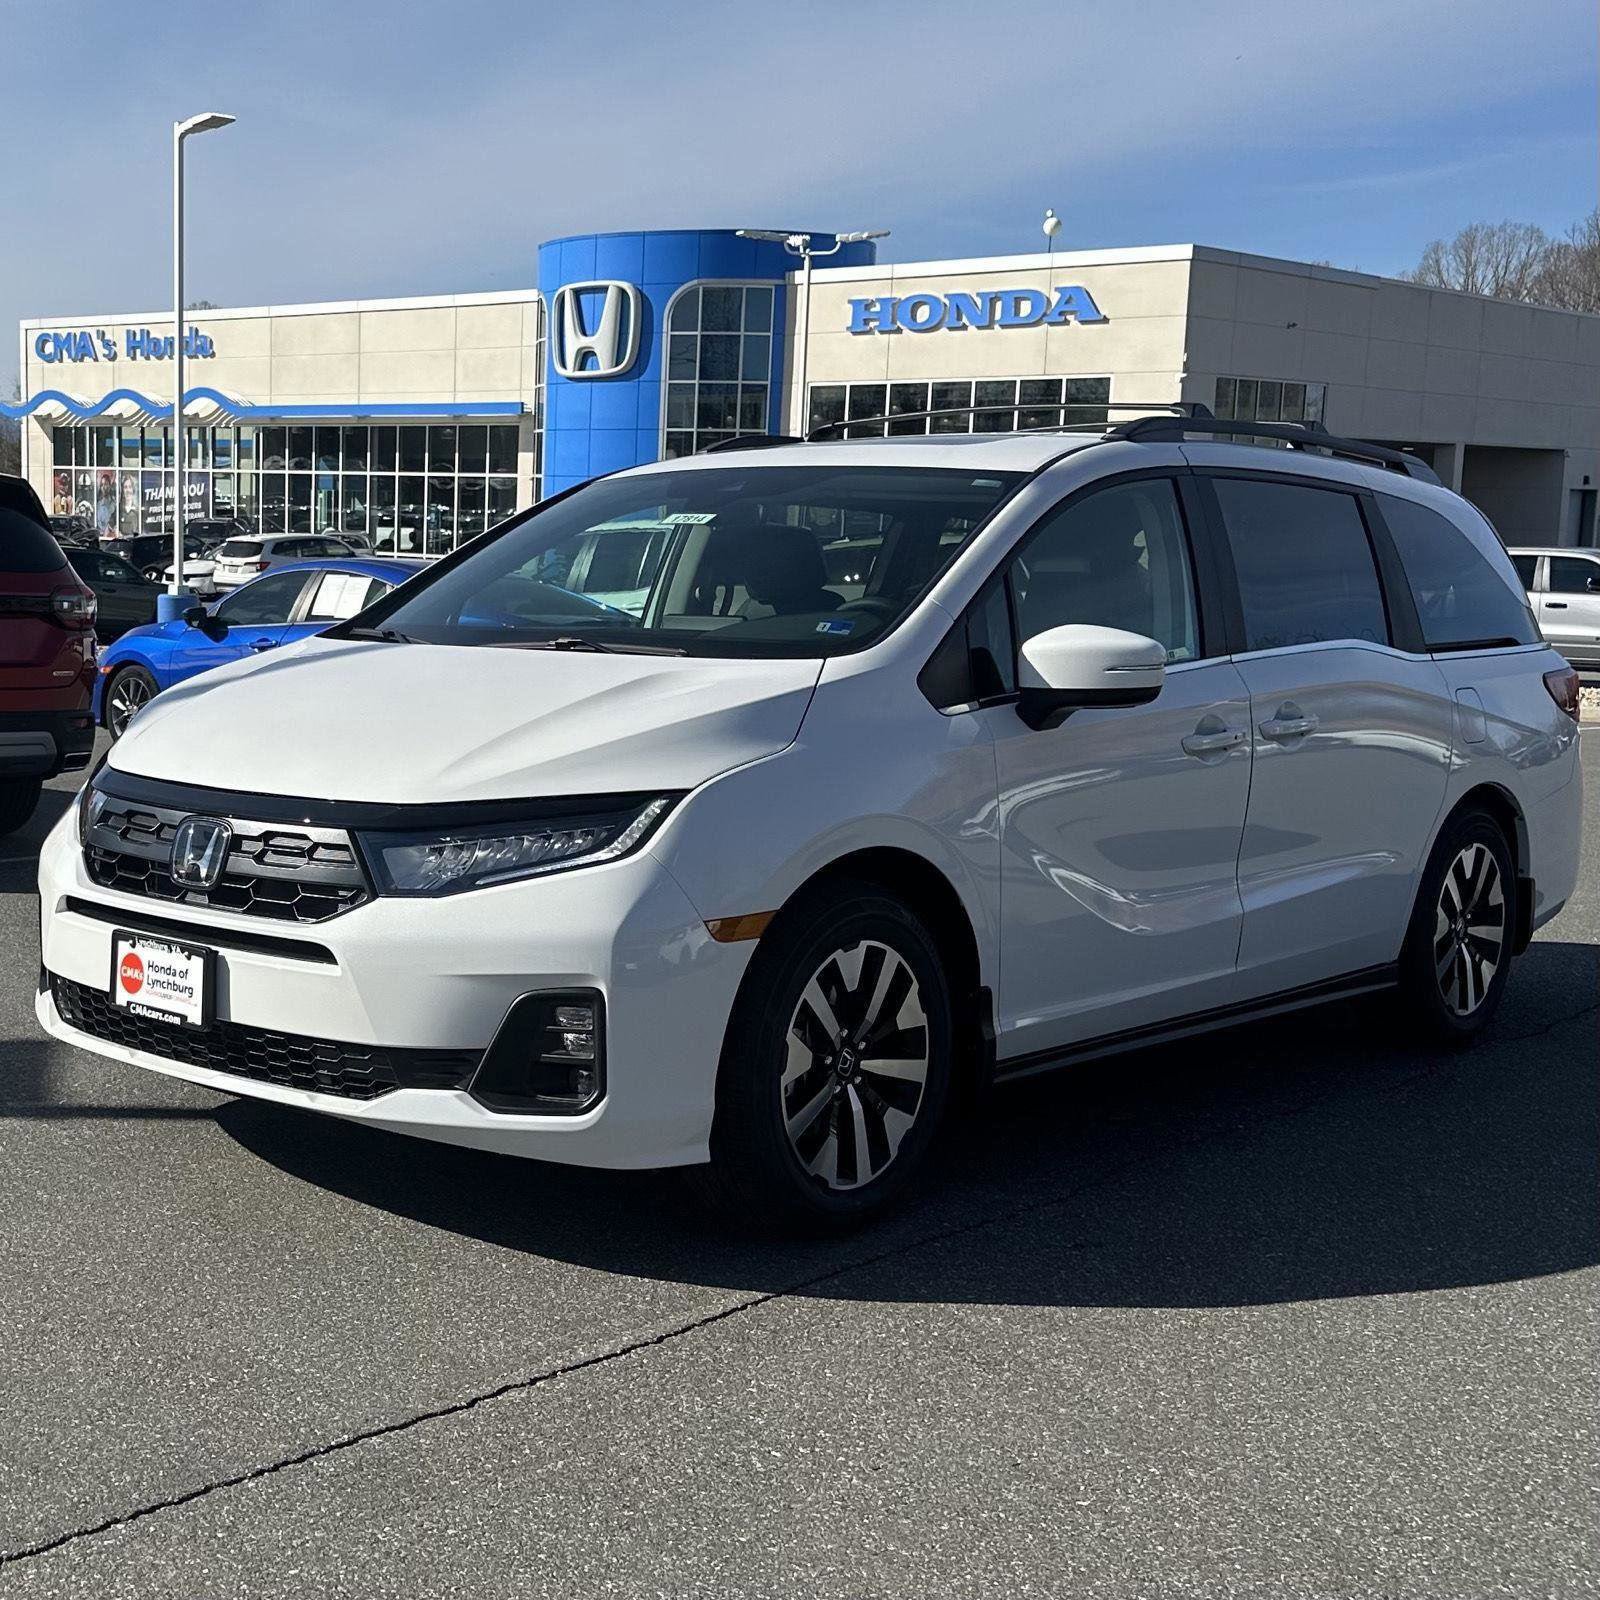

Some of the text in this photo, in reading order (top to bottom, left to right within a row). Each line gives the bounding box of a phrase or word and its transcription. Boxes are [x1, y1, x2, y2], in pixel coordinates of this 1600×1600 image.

[847, 286, 1108, 335] HONDA
[35, 329, 117, 363] CMA's
[147, 960, 189, 980] Honda of
[146, 975, 194, 998] Lynchburg
[130, 1003, 181, 1026] CMAcars.com
